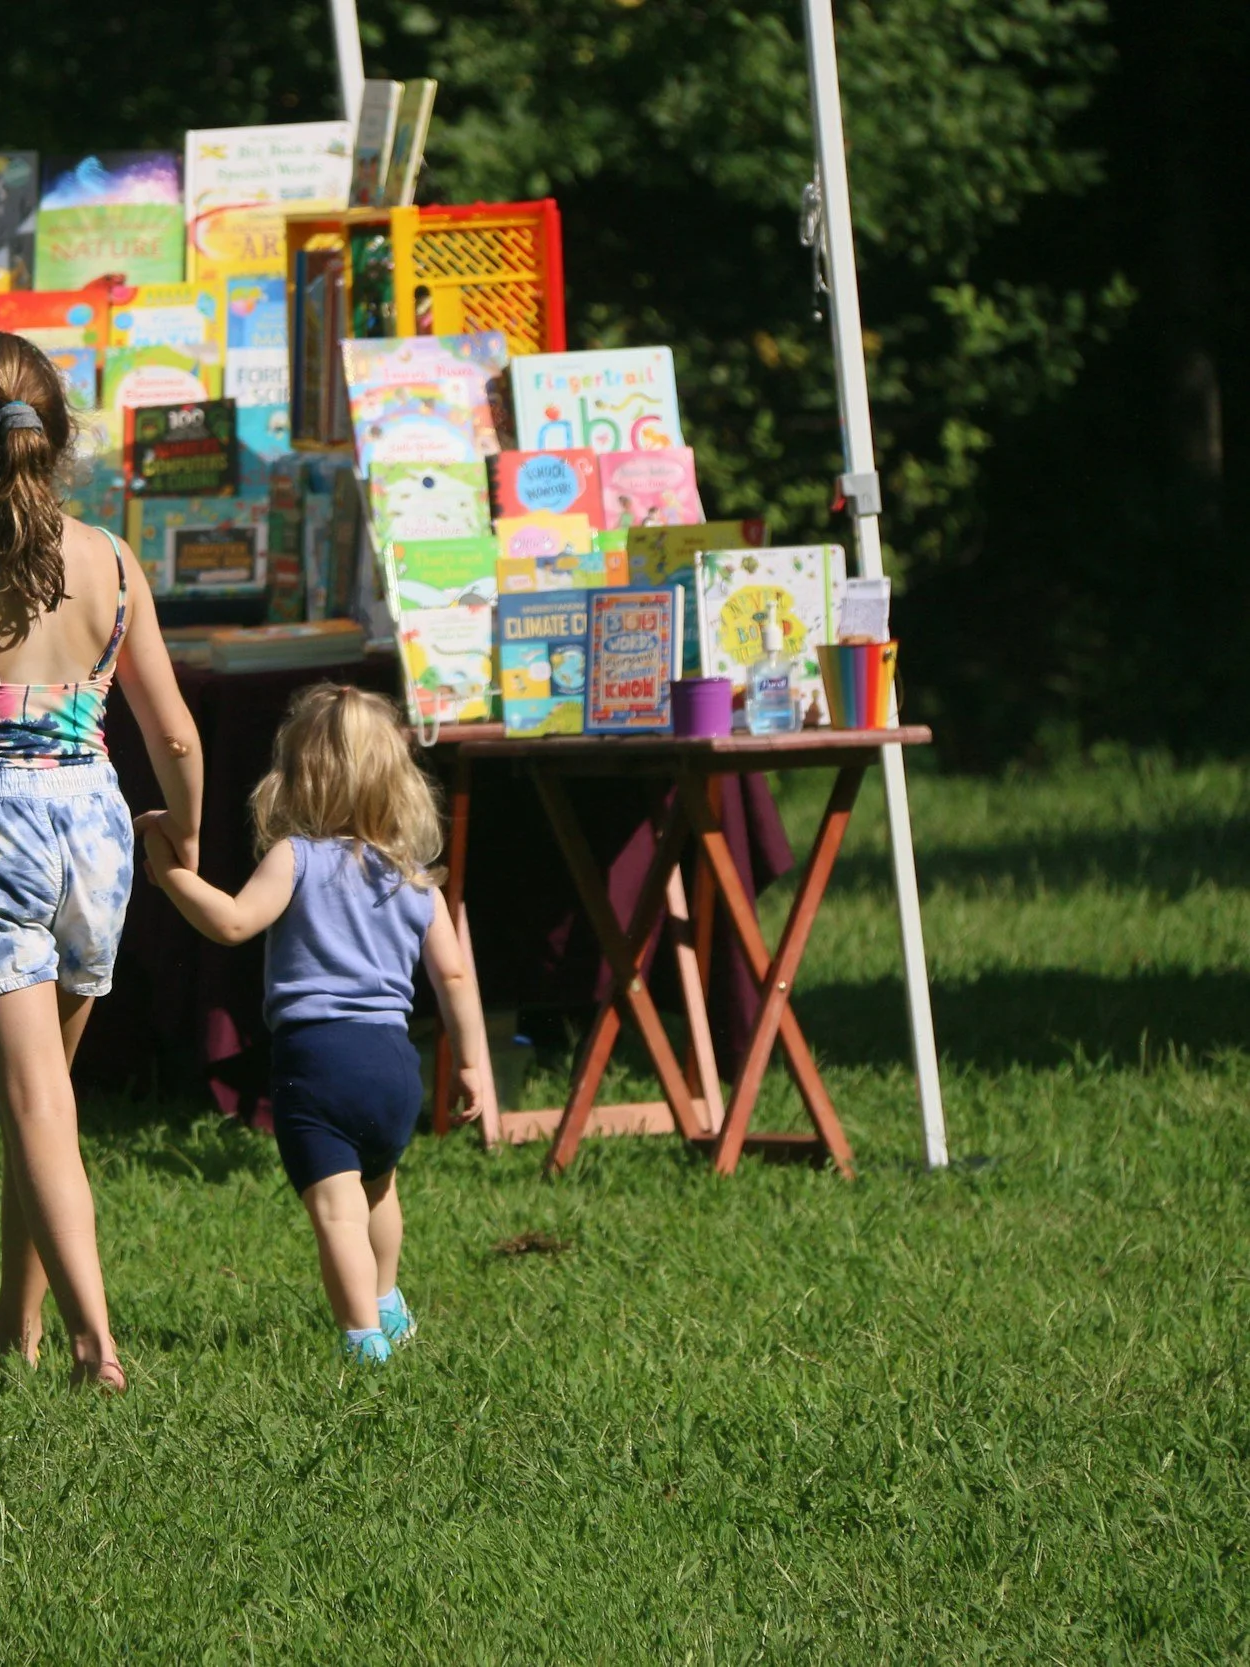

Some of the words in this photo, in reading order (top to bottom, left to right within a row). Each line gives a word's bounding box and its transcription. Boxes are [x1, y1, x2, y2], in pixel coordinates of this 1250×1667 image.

[50, 238, 162, 263] NATURE
[534, 366, 656, 396] Fingertrail
[168, 408, 206, 430] 100
[504, 613, 566, 640] CLIMATE
[605, 677, 655, 699] KNOW
